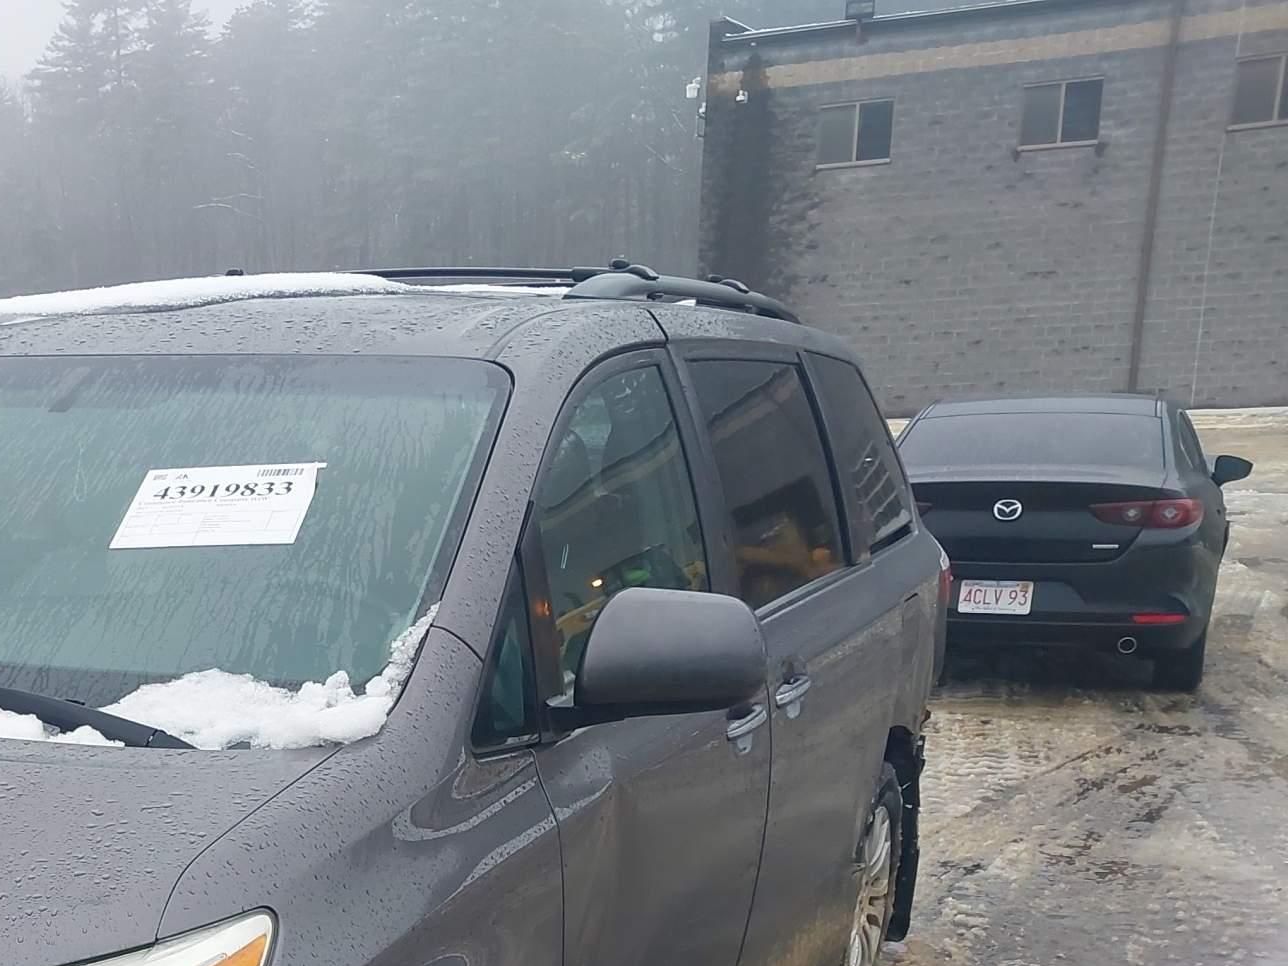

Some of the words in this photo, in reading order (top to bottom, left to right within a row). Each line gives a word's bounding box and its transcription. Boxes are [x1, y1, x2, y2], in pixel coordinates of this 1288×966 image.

[152, 480, 294, 500] 43919833
[962, 588, 1004, 606] 4CLV
[1007, 589, 1029, 607] 93
